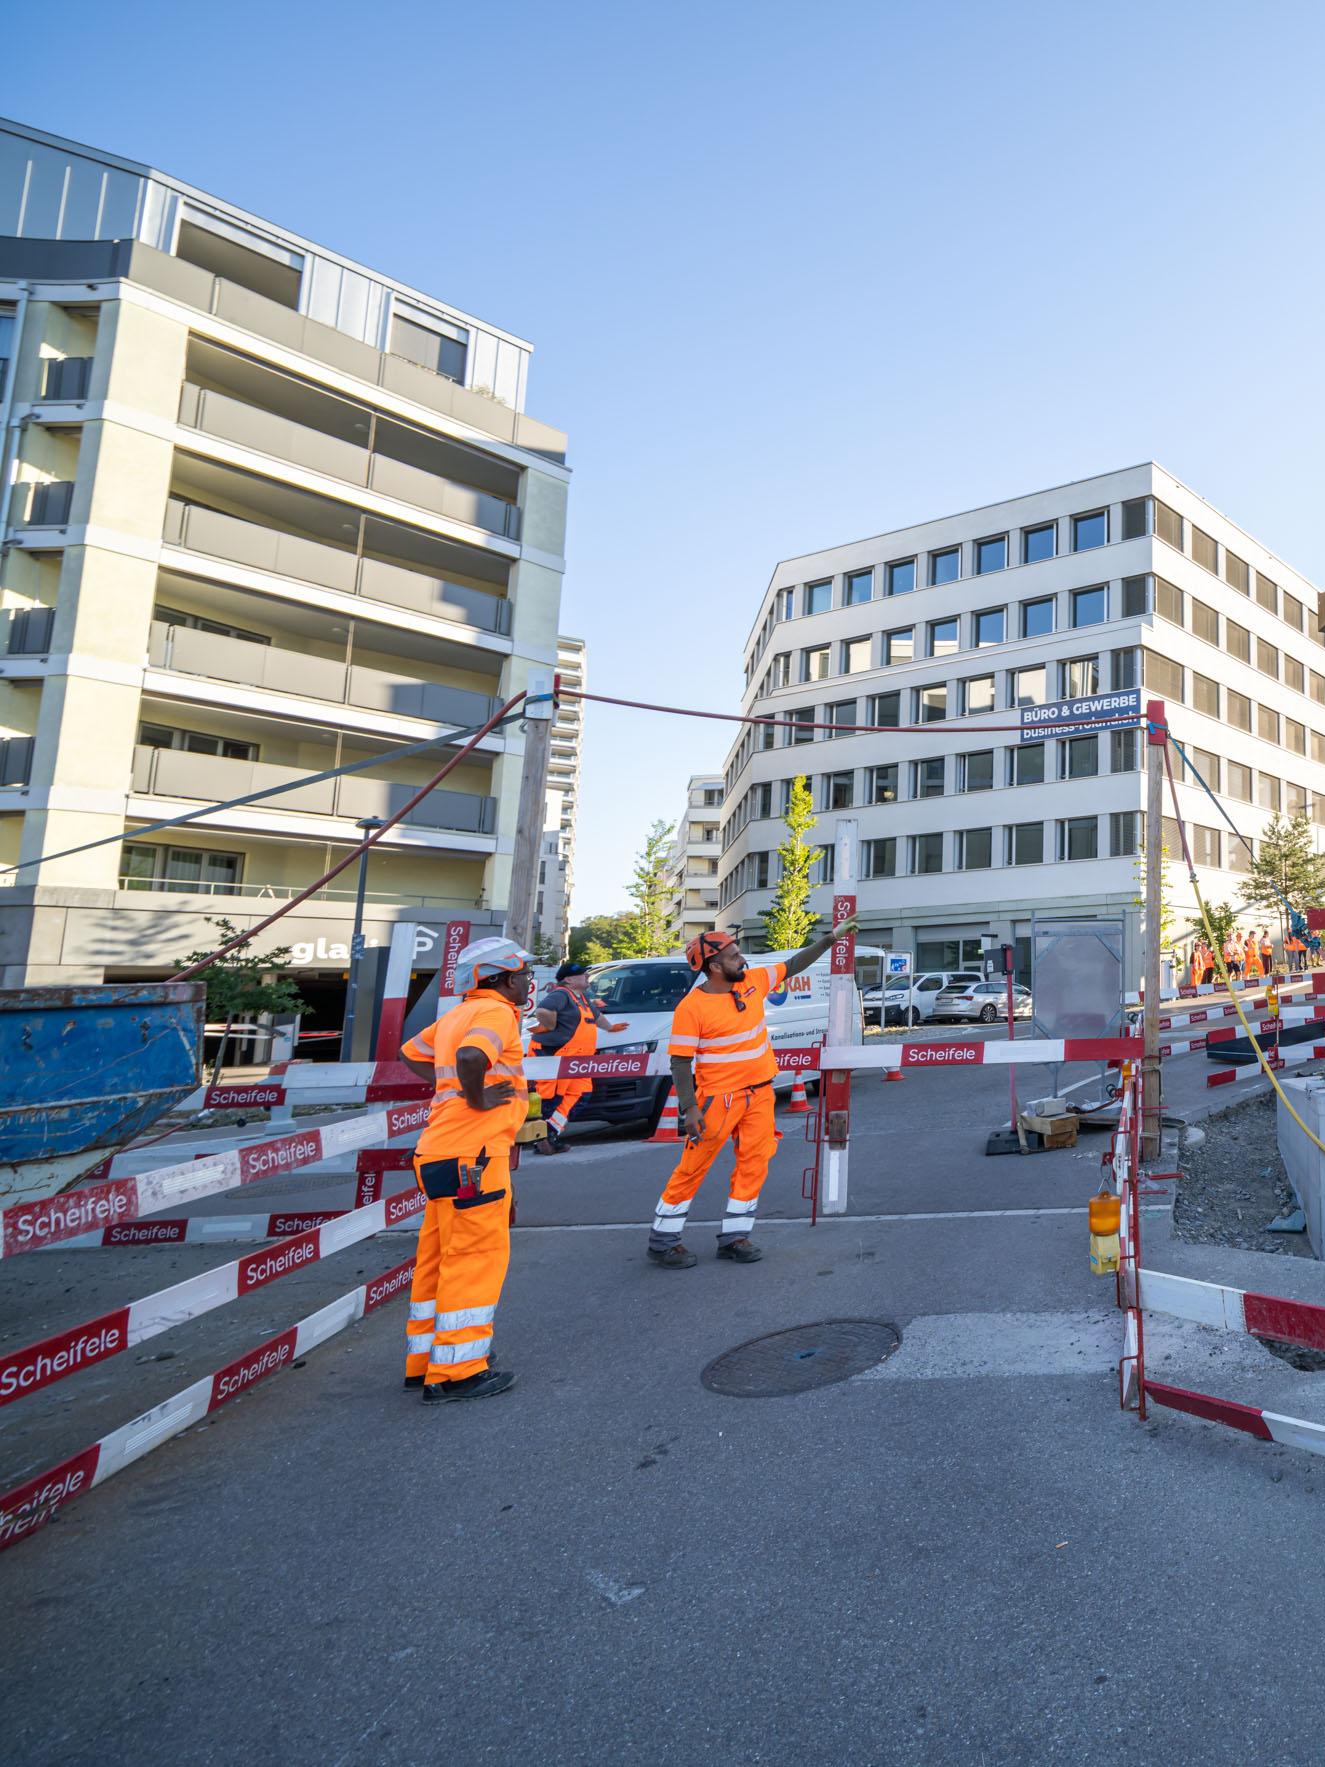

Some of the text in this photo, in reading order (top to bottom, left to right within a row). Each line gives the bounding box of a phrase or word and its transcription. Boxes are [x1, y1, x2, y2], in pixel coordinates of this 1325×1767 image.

[1024, 695, 1137, 722] BÜRO & GEWERBE
[836, 902, 851, 966] Scifele
[568, 1060, 641, 1075] Scheifele
[775, 1052, 812, 1067] eifele
[909, 1048, 976, 1062] Scheifele
[211, 1087, 279, 1106] Scheifele
[392, 1107, 431, 1130] Scheifel
[249, 1141, 316, 1174] Scheifele
[361, 1172, 377, 1205] eifel
[17, 1193, 128, 1242] Scheifele
[390, 1192, 427, 1219] Scheife
[111, 1226, 180, 1242] Scheifele
[247, 1243, 314, 1285] Scheifele
[0, 1328, 120, 1396] Scheifele
[217, 1344, 289, 1400] Scheifele
